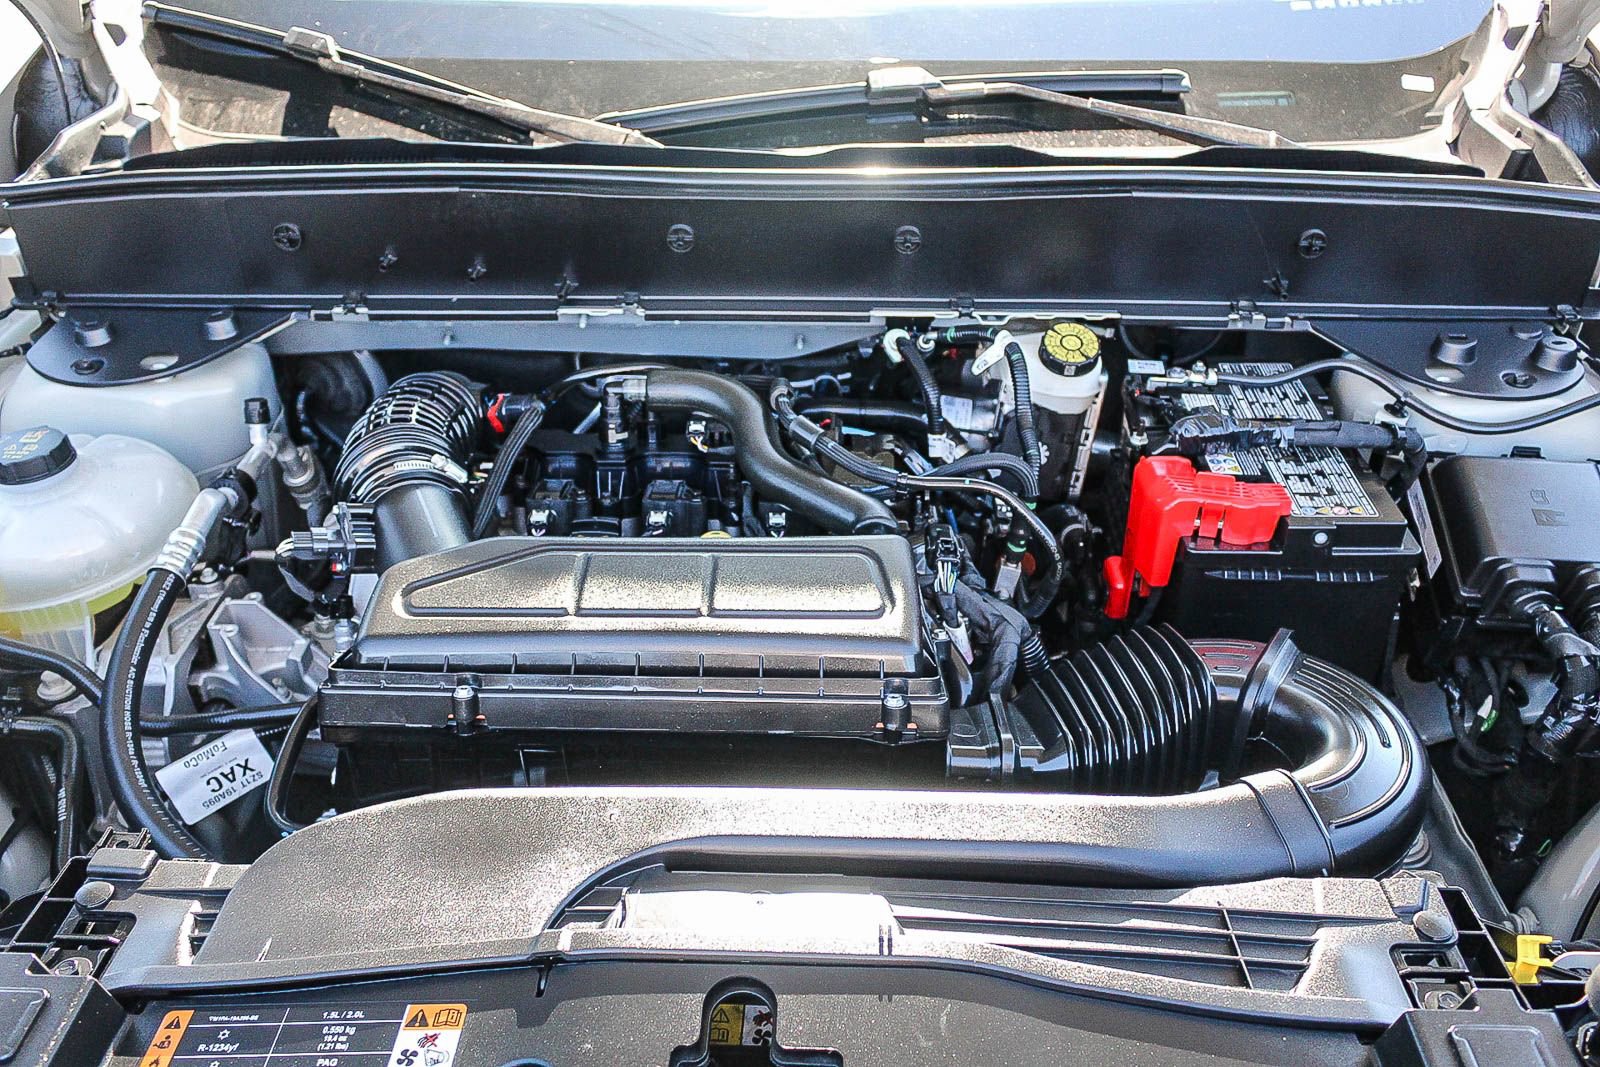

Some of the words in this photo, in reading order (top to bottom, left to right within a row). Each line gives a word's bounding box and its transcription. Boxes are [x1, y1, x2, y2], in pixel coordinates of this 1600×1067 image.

[124, 680, 134, 710] SUCTION
[124, 710, 132, 732] HOSE
[183, 741, 228, 769] FoMoCo
[206, 757, 256, 793] XAC
[202, 786, 237, 809] 19A095
[322, 1011, 340, 1019] 1.5L
[346, 1010, 365, 1019] 2.0L
[322, 1025, 345, 1034] 0.550
[345, 1026, 356, 1035] kg
[197, 1043, 240, 1054] R-1234yf
[316, 1058, 338, 1067] PAG
